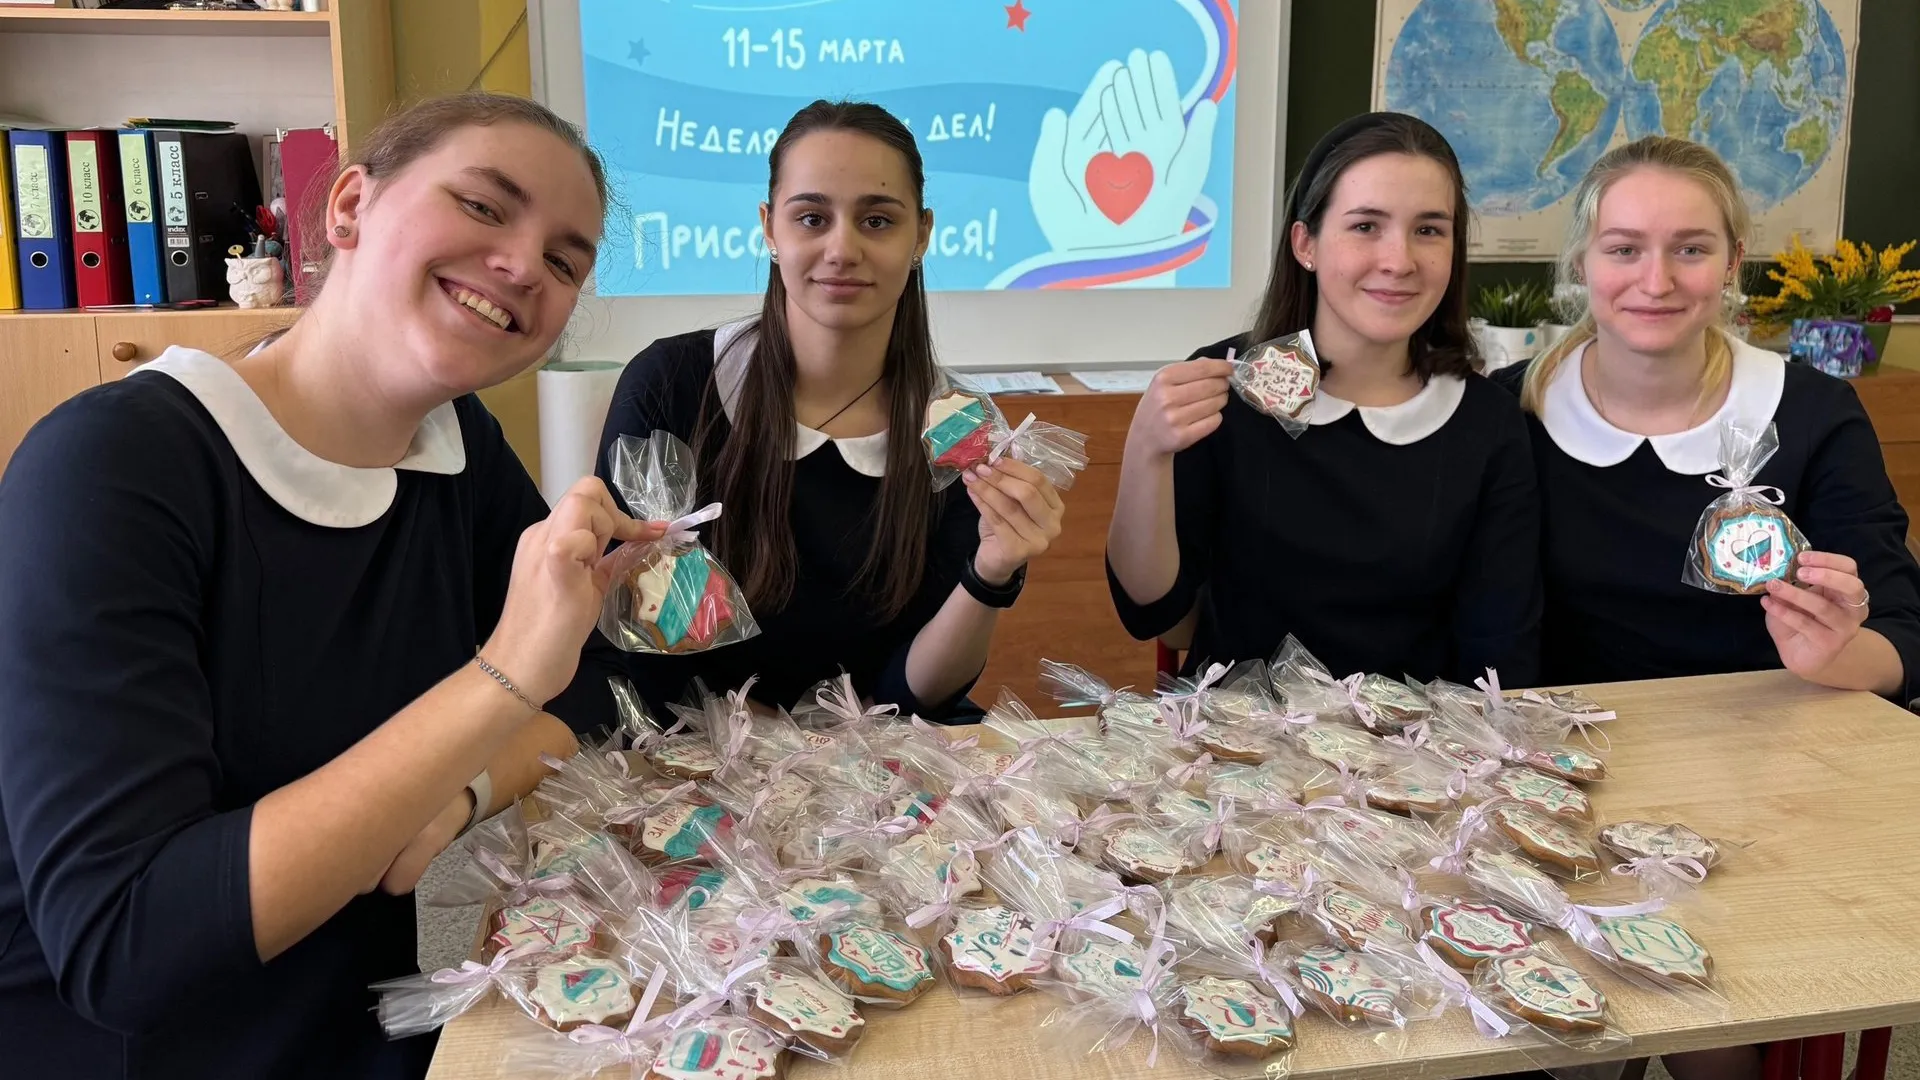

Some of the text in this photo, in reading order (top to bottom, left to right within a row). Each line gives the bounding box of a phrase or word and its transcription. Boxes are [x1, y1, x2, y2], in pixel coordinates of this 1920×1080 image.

[722, 27, 806, 70] 11-15
[82, 161, 94, 203] 10 класс
[132, 158, 143, 186] класс
[169, 145, 184, 200] 5 класс
